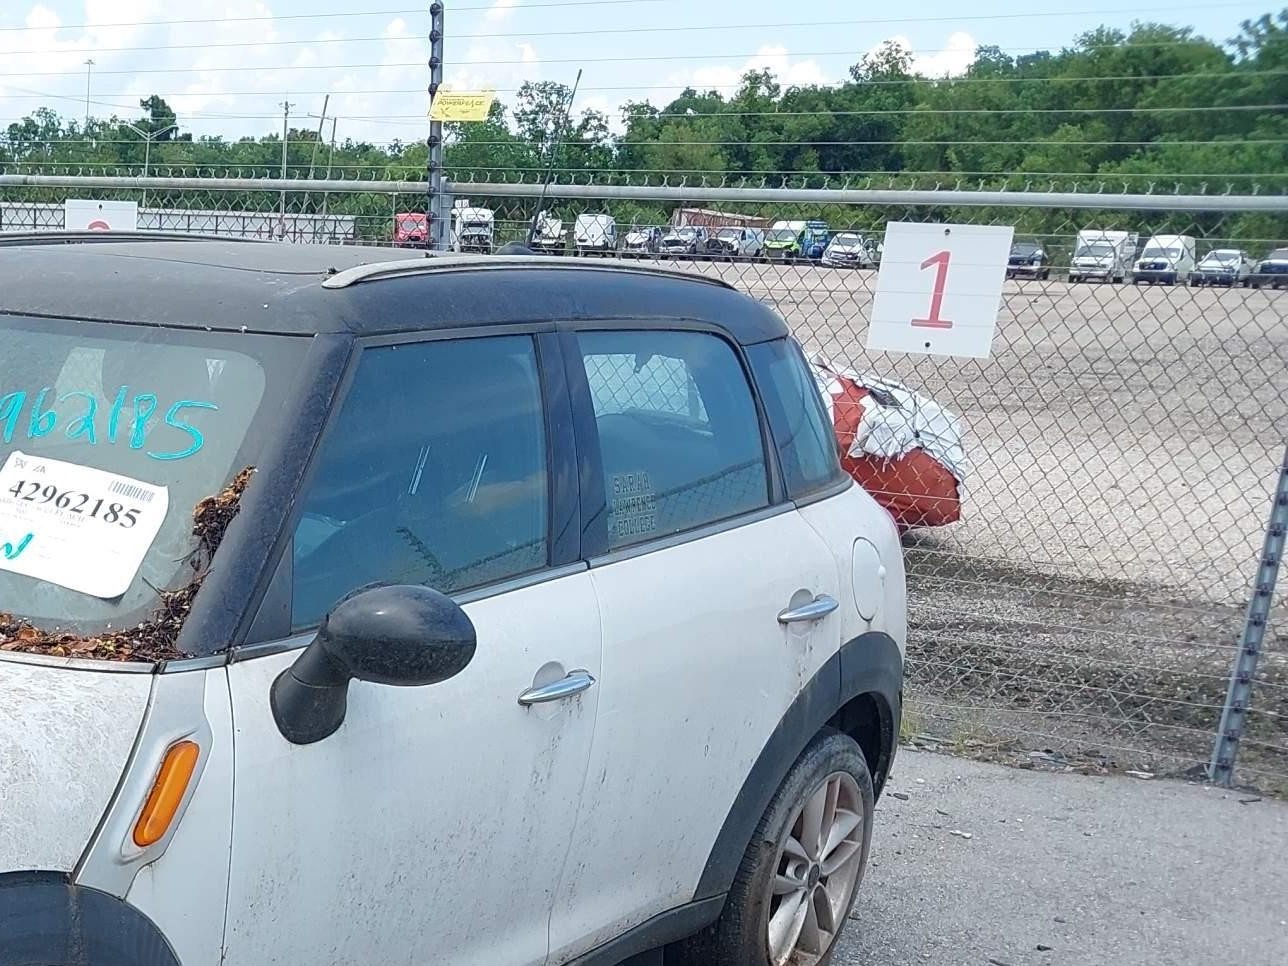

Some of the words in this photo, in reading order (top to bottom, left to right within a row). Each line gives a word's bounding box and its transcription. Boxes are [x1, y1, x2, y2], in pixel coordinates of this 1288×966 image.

[911, 250, 953, 329] 1
[8, 479, 143, 529] 42962185
[617, 515, 657, 537] COLLEGE
